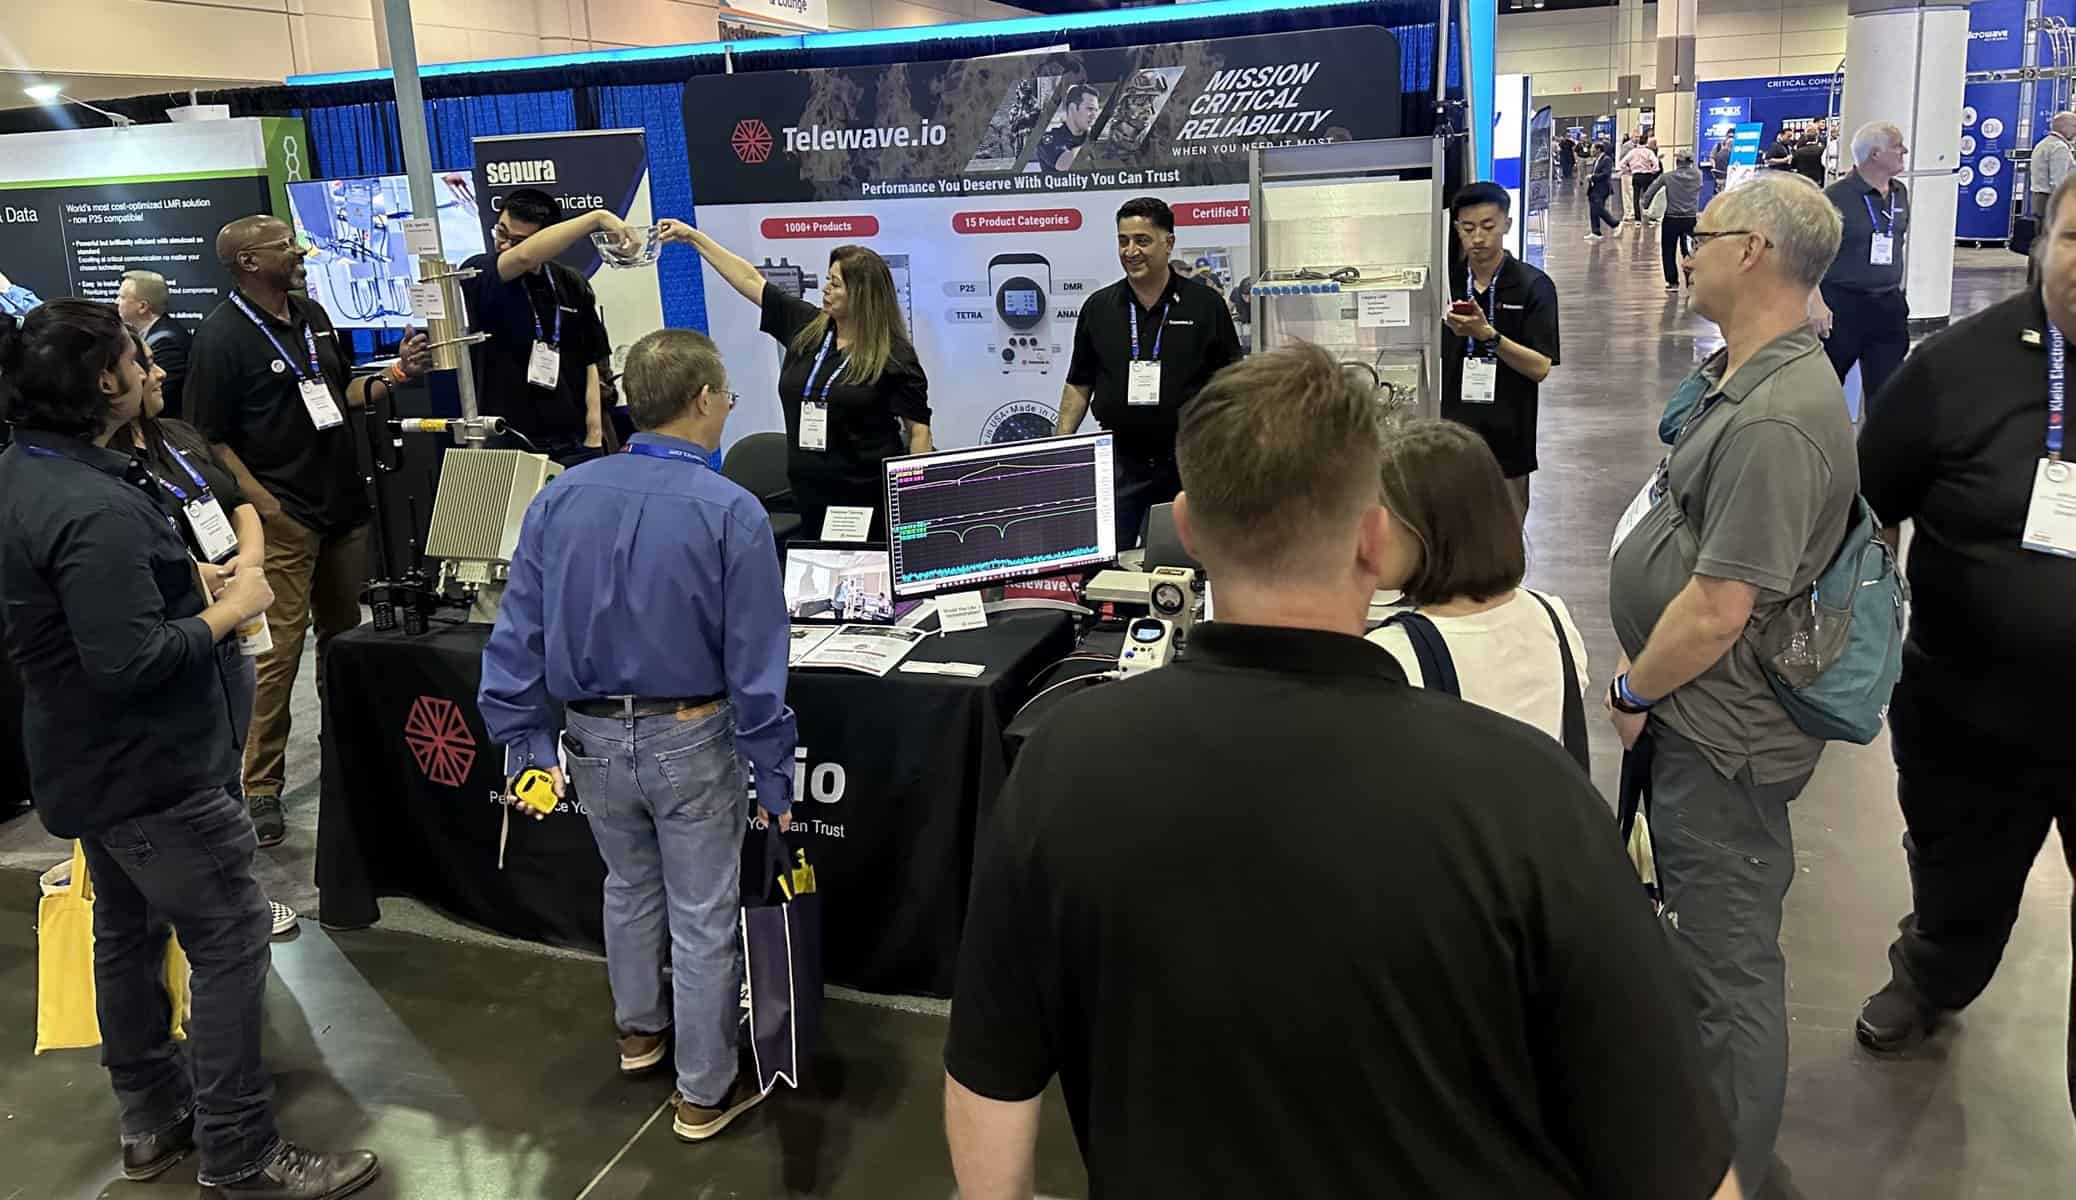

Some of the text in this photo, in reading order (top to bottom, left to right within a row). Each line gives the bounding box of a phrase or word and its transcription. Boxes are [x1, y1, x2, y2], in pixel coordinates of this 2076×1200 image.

[1204, 62, 1320, 92] MISSION
[1767, 79, 1806, 88] CRITICAL
[1189, 86, 1303, 116] CRITICAL
[1175, 109, 1334, 141] RELIABILITY
[782, 118, 946, 152] Telewave.io
[1172, 145, 1207, 157] WHEN
[1213, 143, 1237, 154] YOU
[486, 160, 556, 185] sepura
[861, 168, 1180, 196] Performance You Deserve With Quality You Can Trust
[93, 203, 110, 212] most
[182, 198, 210, 208] solution
[491, 192, 604, 213] Cnicate
[5, 206, 39, 223] Data
[1193, 206, 1239, 218] Certified
[785, 221, 852, 233] 1000+ Products
[965, 213, 1070, 228] 15 Product Categories
[959, 284, 976, 293] P25
[1063, 282, 1083, 291] DMR
[956, 311, 983, 320] TETRA
[790, 821, 808, 833] an
[811, 819, 845, 838] Trust
